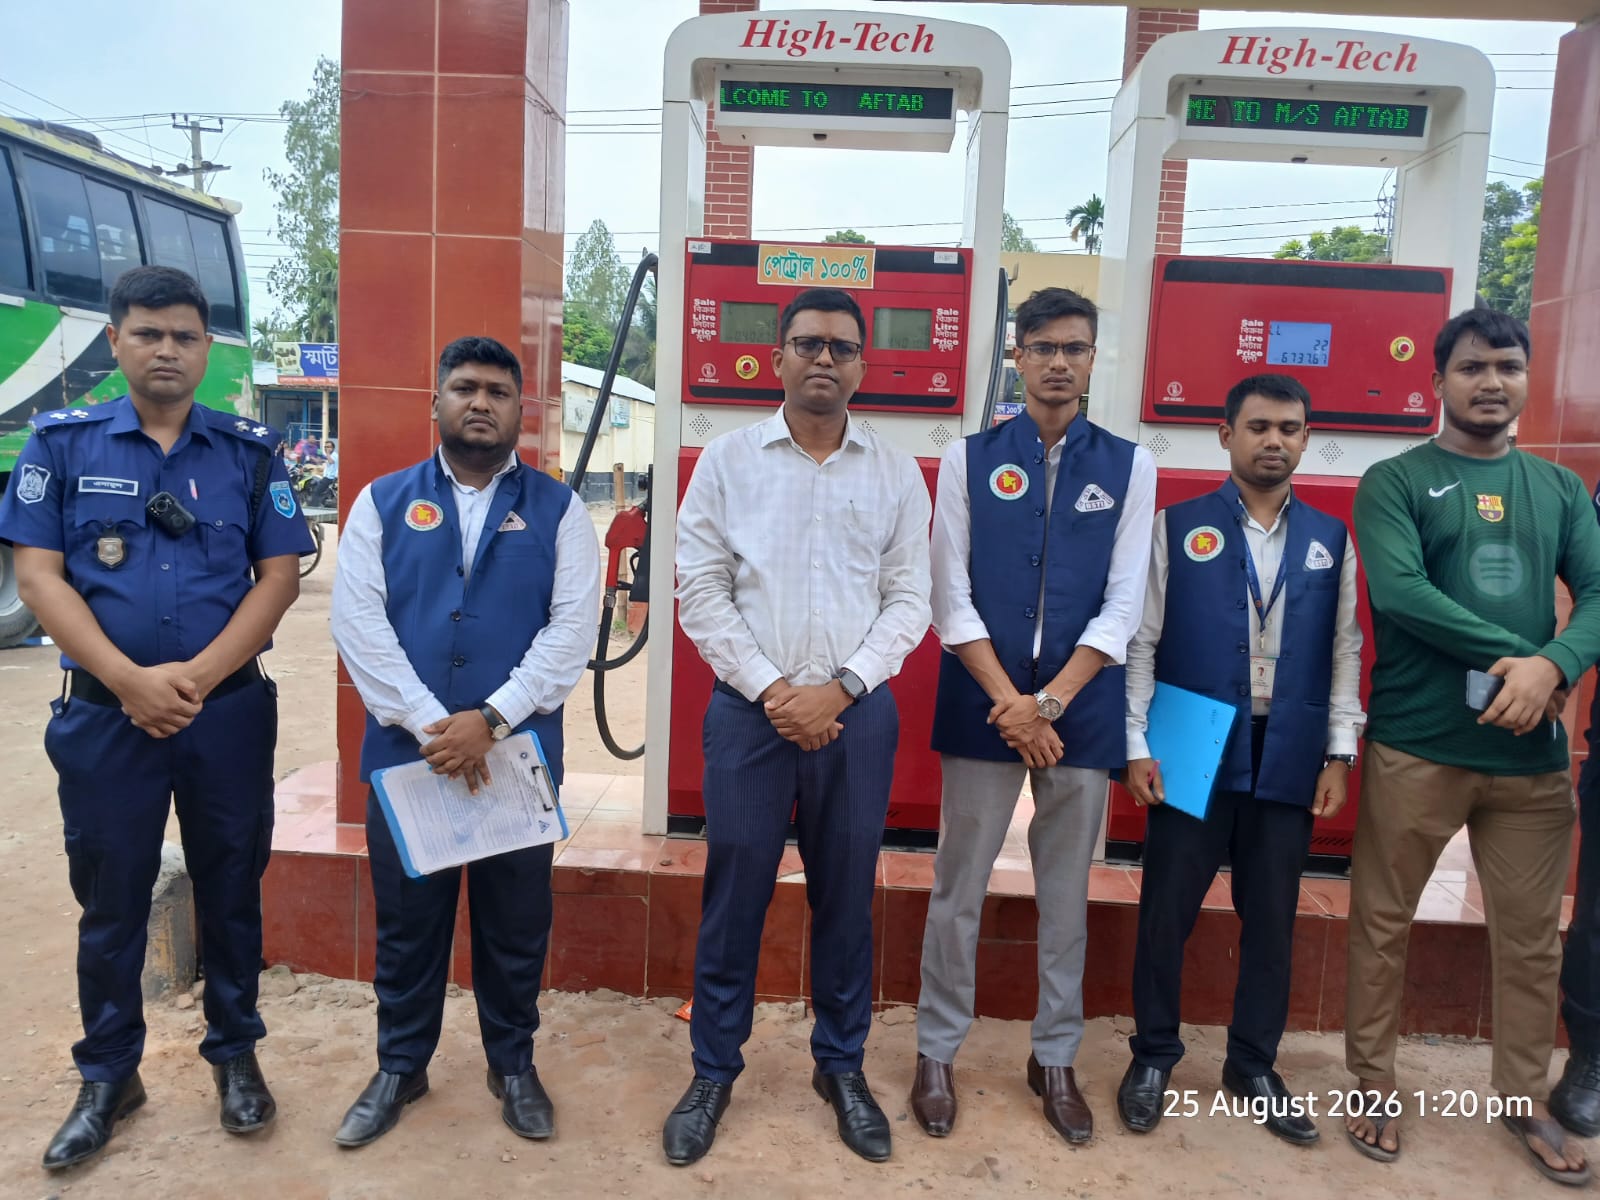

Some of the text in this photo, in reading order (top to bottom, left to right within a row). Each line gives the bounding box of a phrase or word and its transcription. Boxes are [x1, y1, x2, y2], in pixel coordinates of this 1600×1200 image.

[739, 19, 935, 57] High-Tech
[1218, 36, 1418, 75] High-Tech
[800, 90, 828, 108] TO
[858, 92, 925, 112] AFTAB
[1233, 100, 1261, 123] TO
[1274, 102, 1321, 126] M/S
[1334, 105, 1409, 129] AFTAB
[764, 248, 868, 281] পেট্রোল ১০০%
[694, 298, 716, 306] Sale
[936, 308, 959, 316] Sale
[692, 313, 716, 321] Litre
[935, 323, 959, 331] Litre
[1241, 319, 1264, 327] Sale
[691, 328, 717, 336] Price
[932, 337, 959, 345] Price
[1239, 334, 1264, 342] Litre
[1236, 349, 1263, 357] Price
